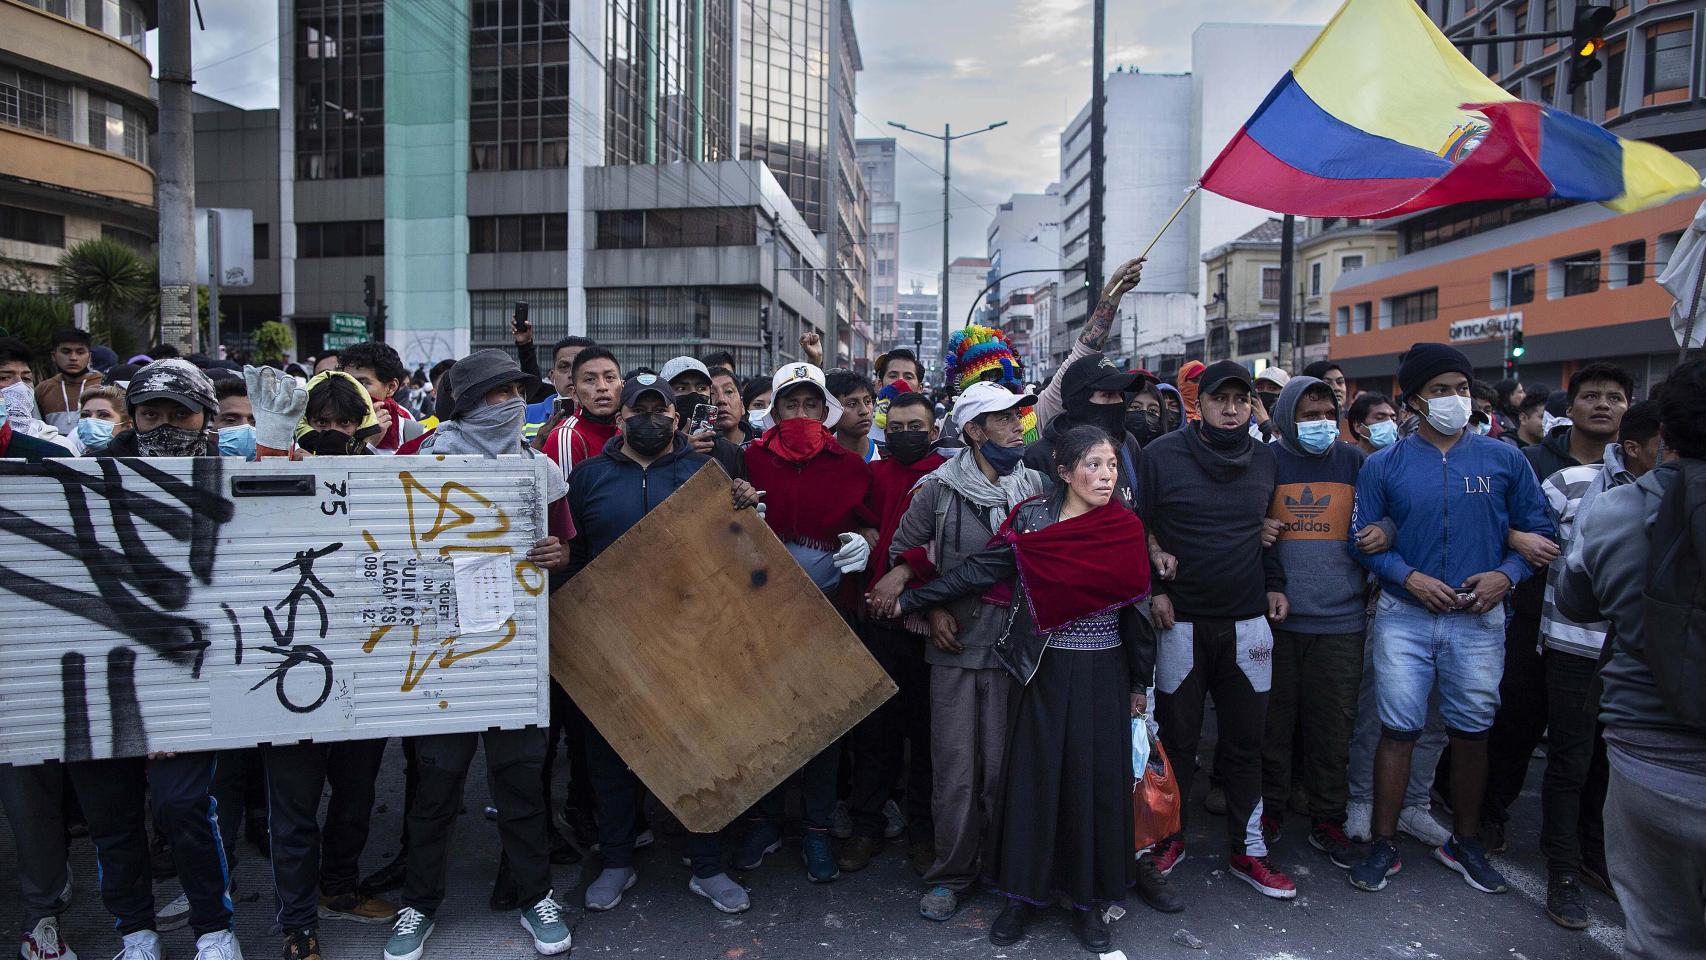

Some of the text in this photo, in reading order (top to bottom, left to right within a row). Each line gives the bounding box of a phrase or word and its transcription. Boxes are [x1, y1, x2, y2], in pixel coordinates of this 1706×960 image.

[1463, 475, 1492, 494] LN
[320, 480, 348, 516] 75
[1283, 519, 1331, 533] adidas
